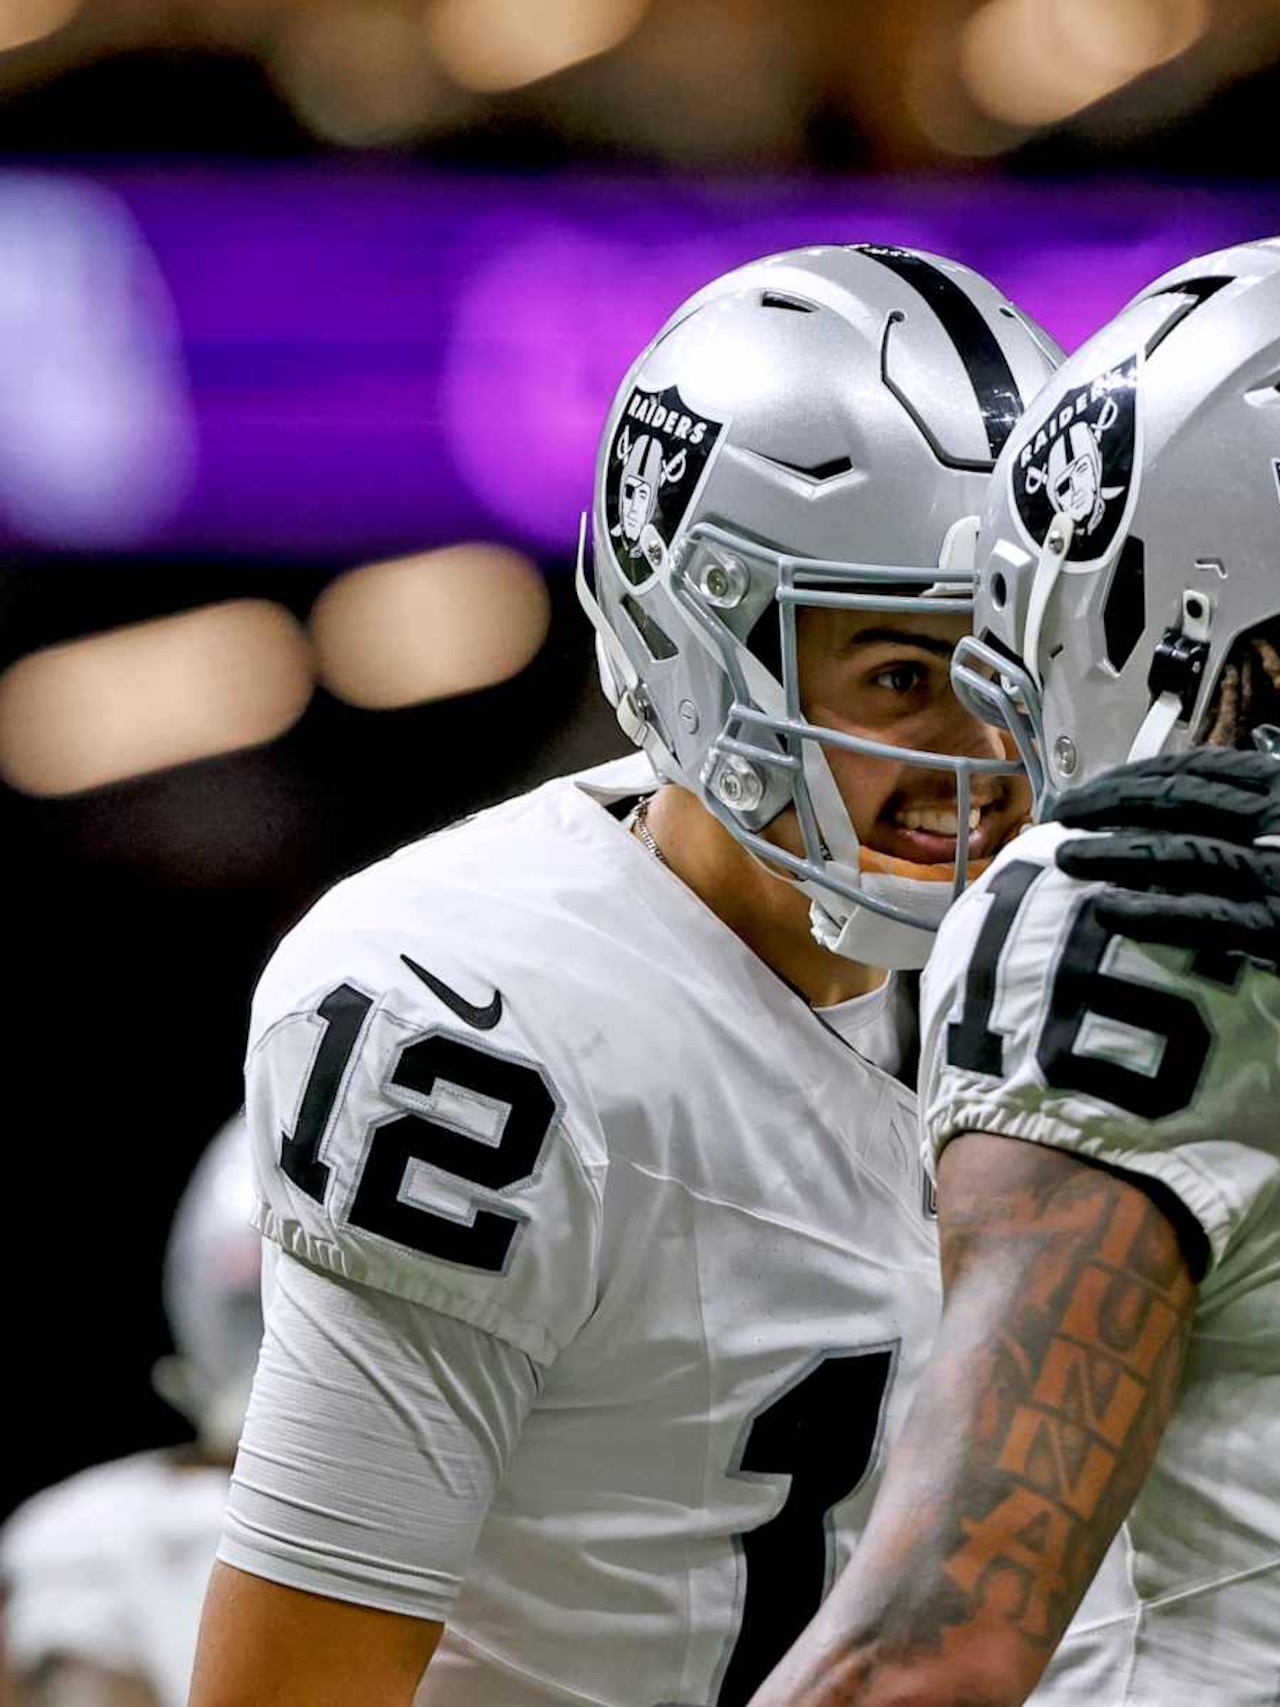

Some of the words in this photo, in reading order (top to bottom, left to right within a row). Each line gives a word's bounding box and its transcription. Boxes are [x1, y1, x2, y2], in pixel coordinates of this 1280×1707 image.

[627, 394, 708, 444] RAIDERS
[946, 859, 1247, 1121] 16
[279, 980, 562, 1273] 12
